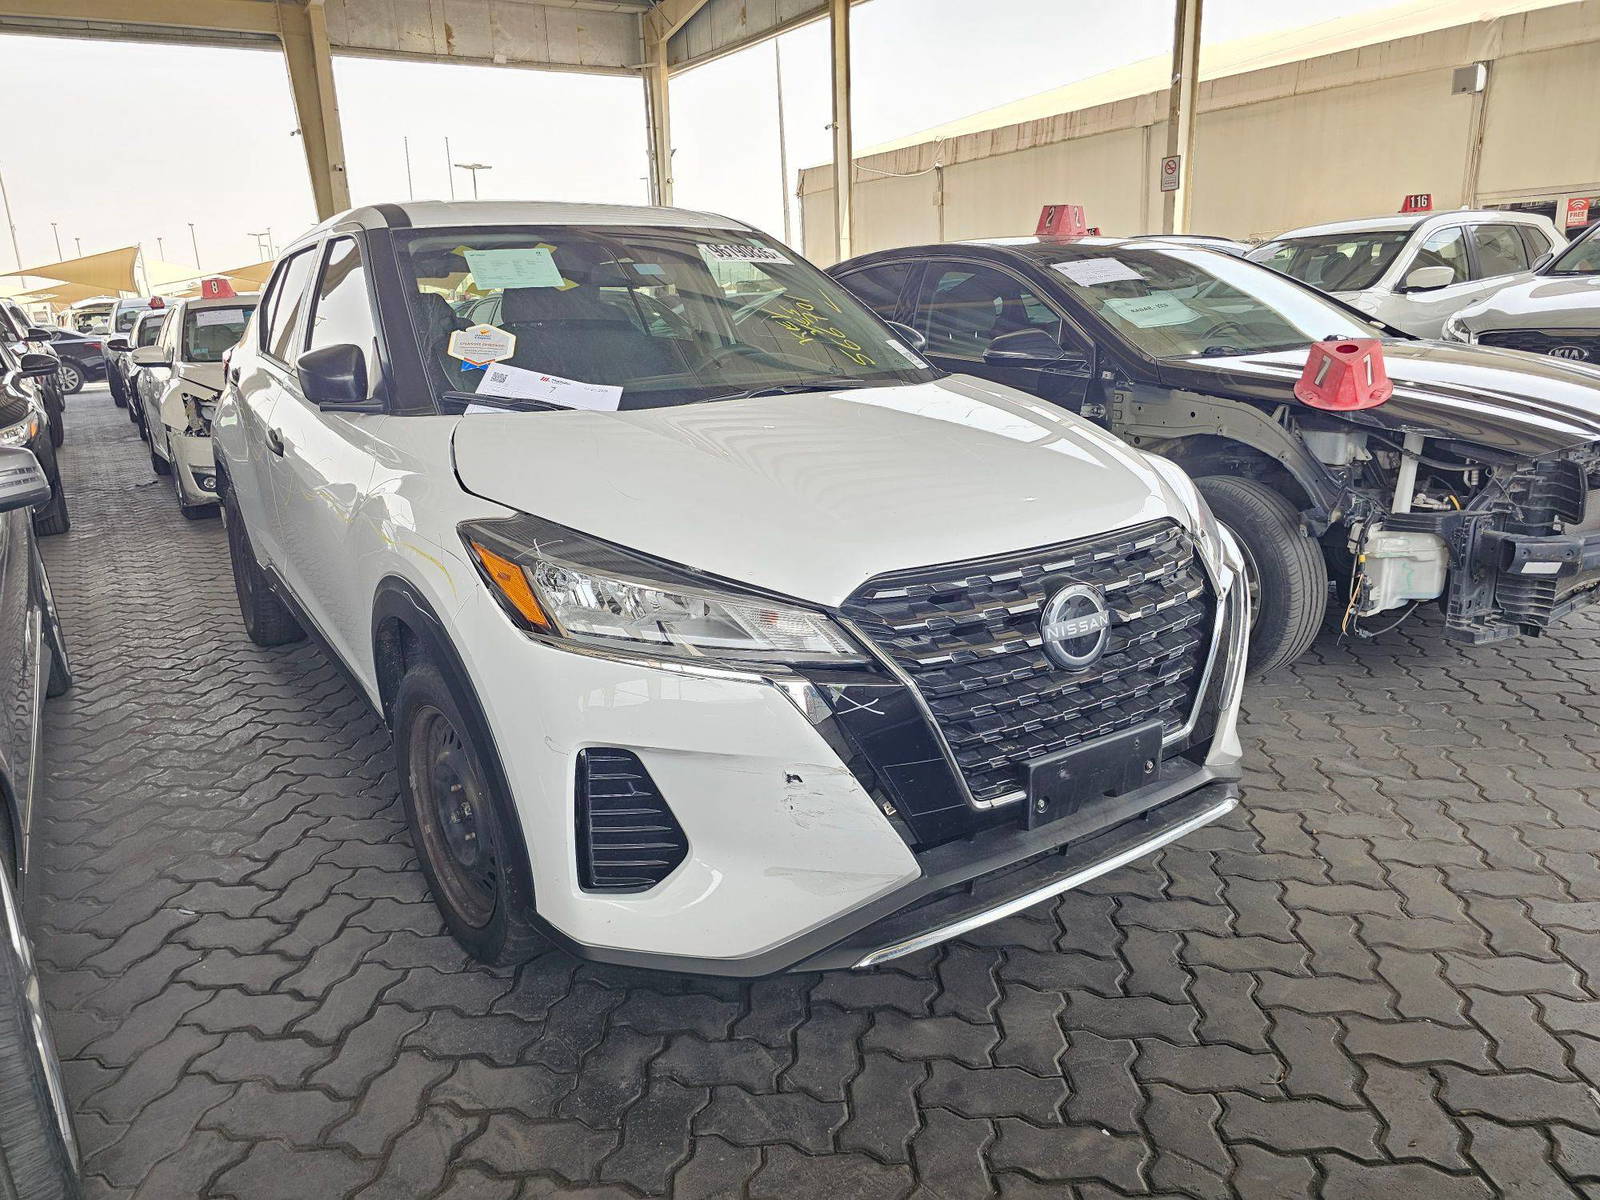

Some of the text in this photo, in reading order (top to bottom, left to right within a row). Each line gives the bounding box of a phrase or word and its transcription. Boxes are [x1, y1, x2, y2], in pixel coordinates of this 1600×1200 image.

[1410, 195, 1428, 208] 116
[1045, 206, 1055, 228] 2
[211, 280, 219, 295] 8
[1554, 349, 1580, 360] KIA
[1046, 612, 1108, 640] NISSAN
